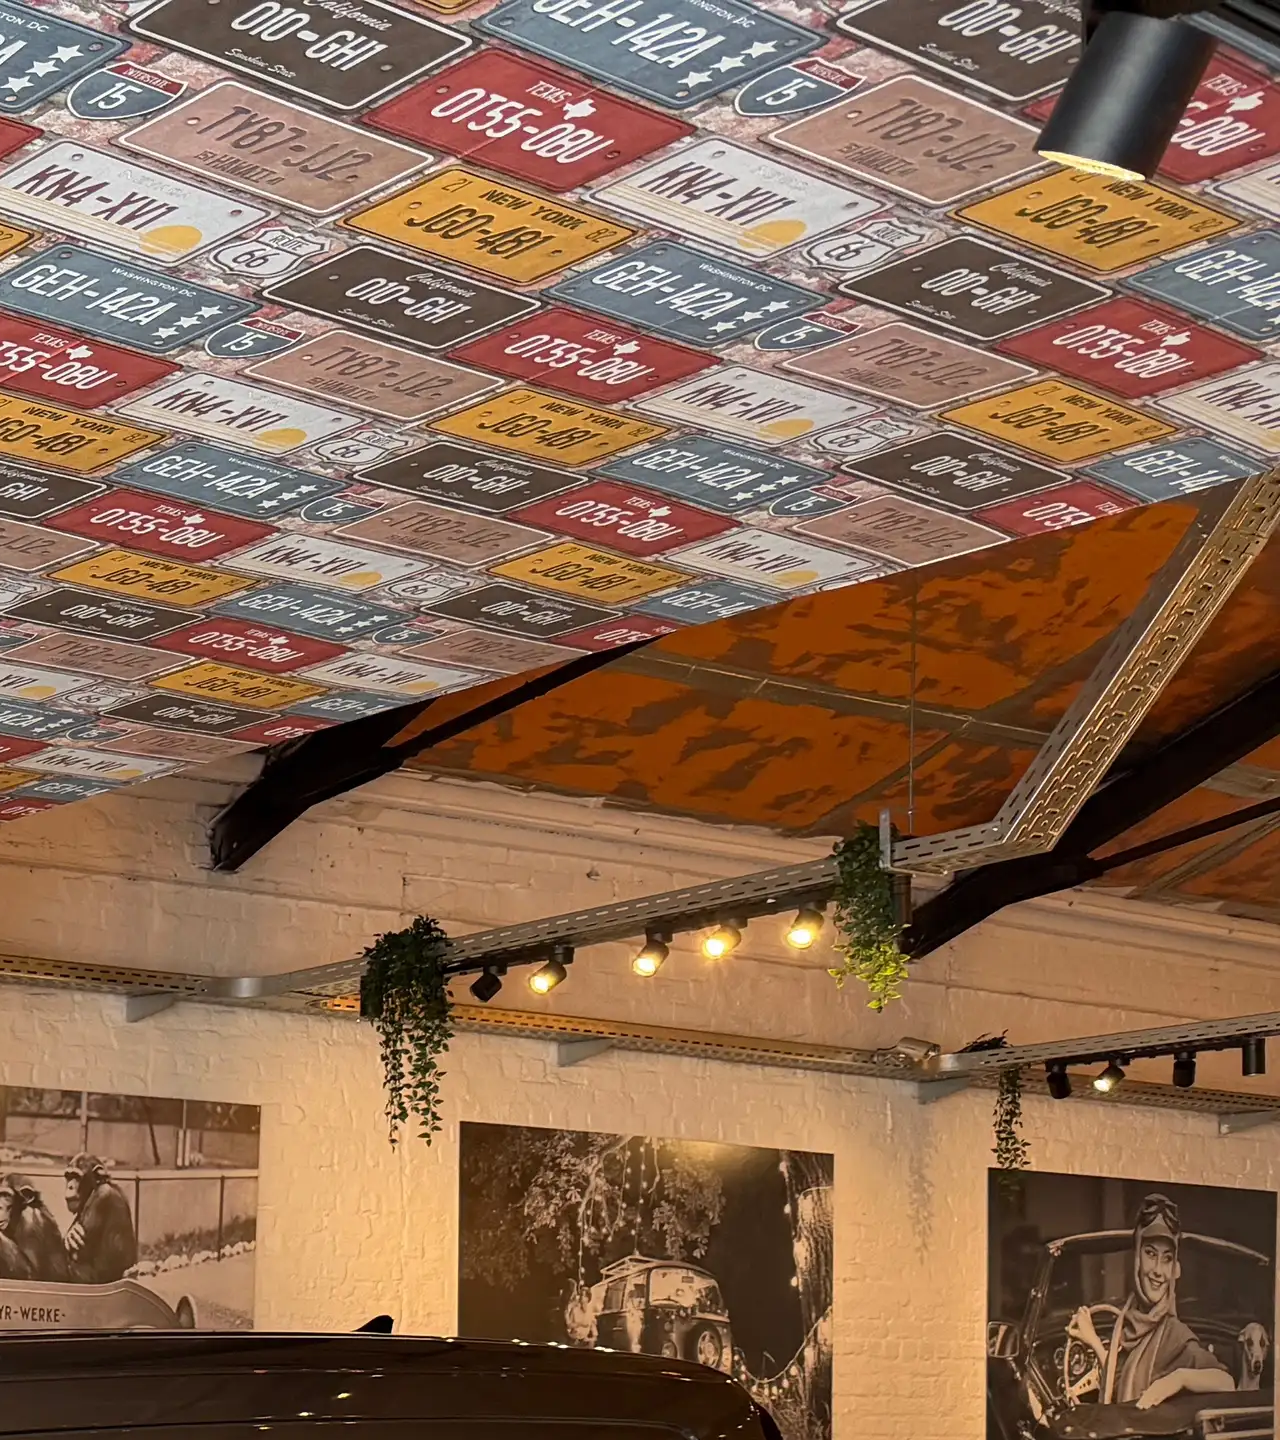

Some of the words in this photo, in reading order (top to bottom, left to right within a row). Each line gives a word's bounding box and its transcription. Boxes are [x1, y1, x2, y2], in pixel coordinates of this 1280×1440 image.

[86, 81, 145, 110] 15
[754, 77, 819, 106] 15
[474, 189, 532, 212] NEW
[523, 206, 586, 232] YORK
[232, 247, 283, 268] 66
